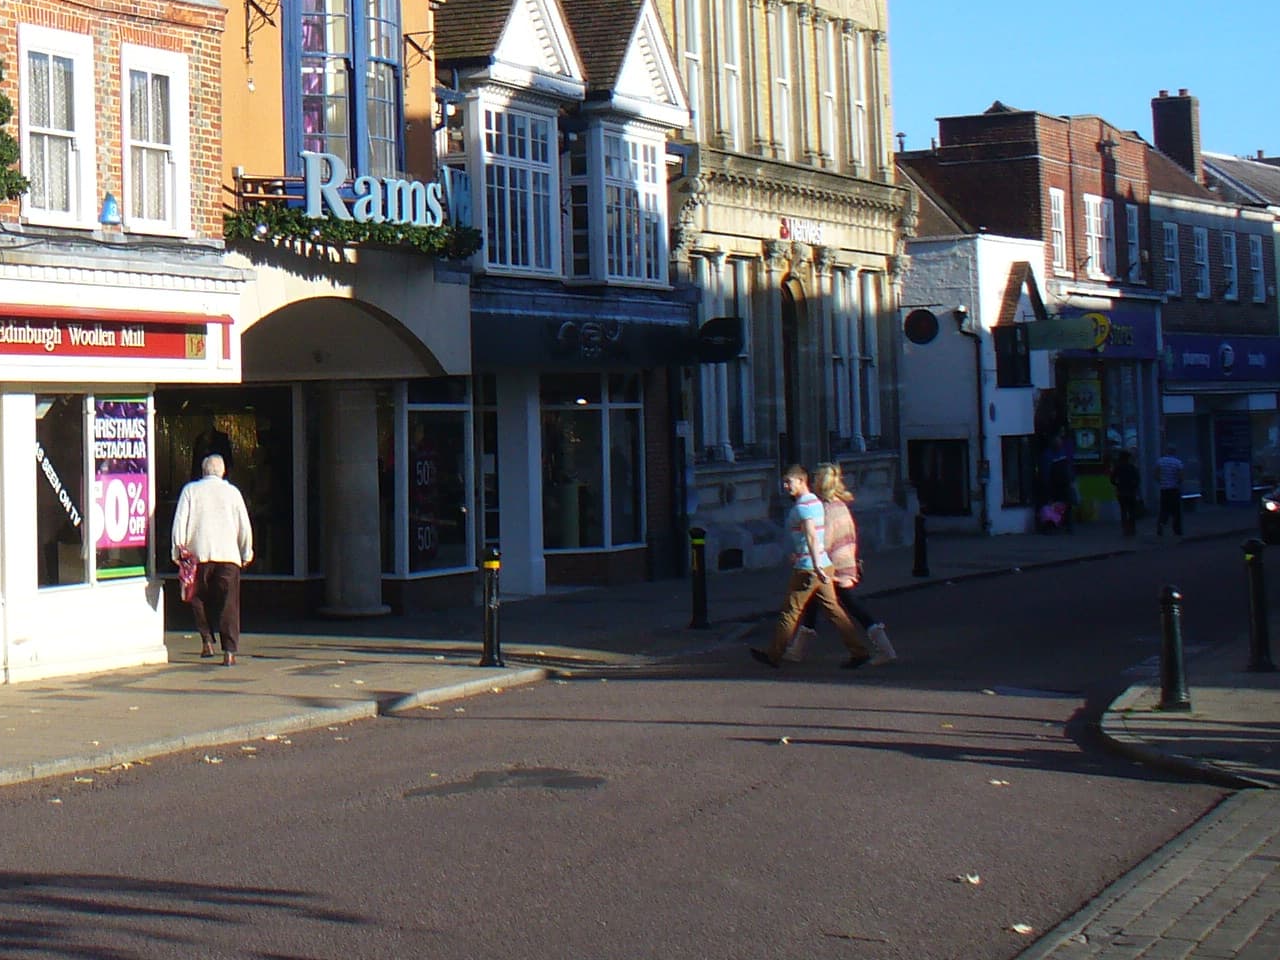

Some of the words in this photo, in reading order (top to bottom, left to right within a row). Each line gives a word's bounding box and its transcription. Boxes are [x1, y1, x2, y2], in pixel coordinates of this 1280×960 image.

[299, 150, 443, 227] Rams
[68, 323, 116, 347] Woollen
[120, 325, 145, 348] Mill
[42, 457, 62, 495] SEEN
[60, 489, 72, 513] ON
[71, 505, 82, 527] TV
[129, 516, 146, 536] OFF
